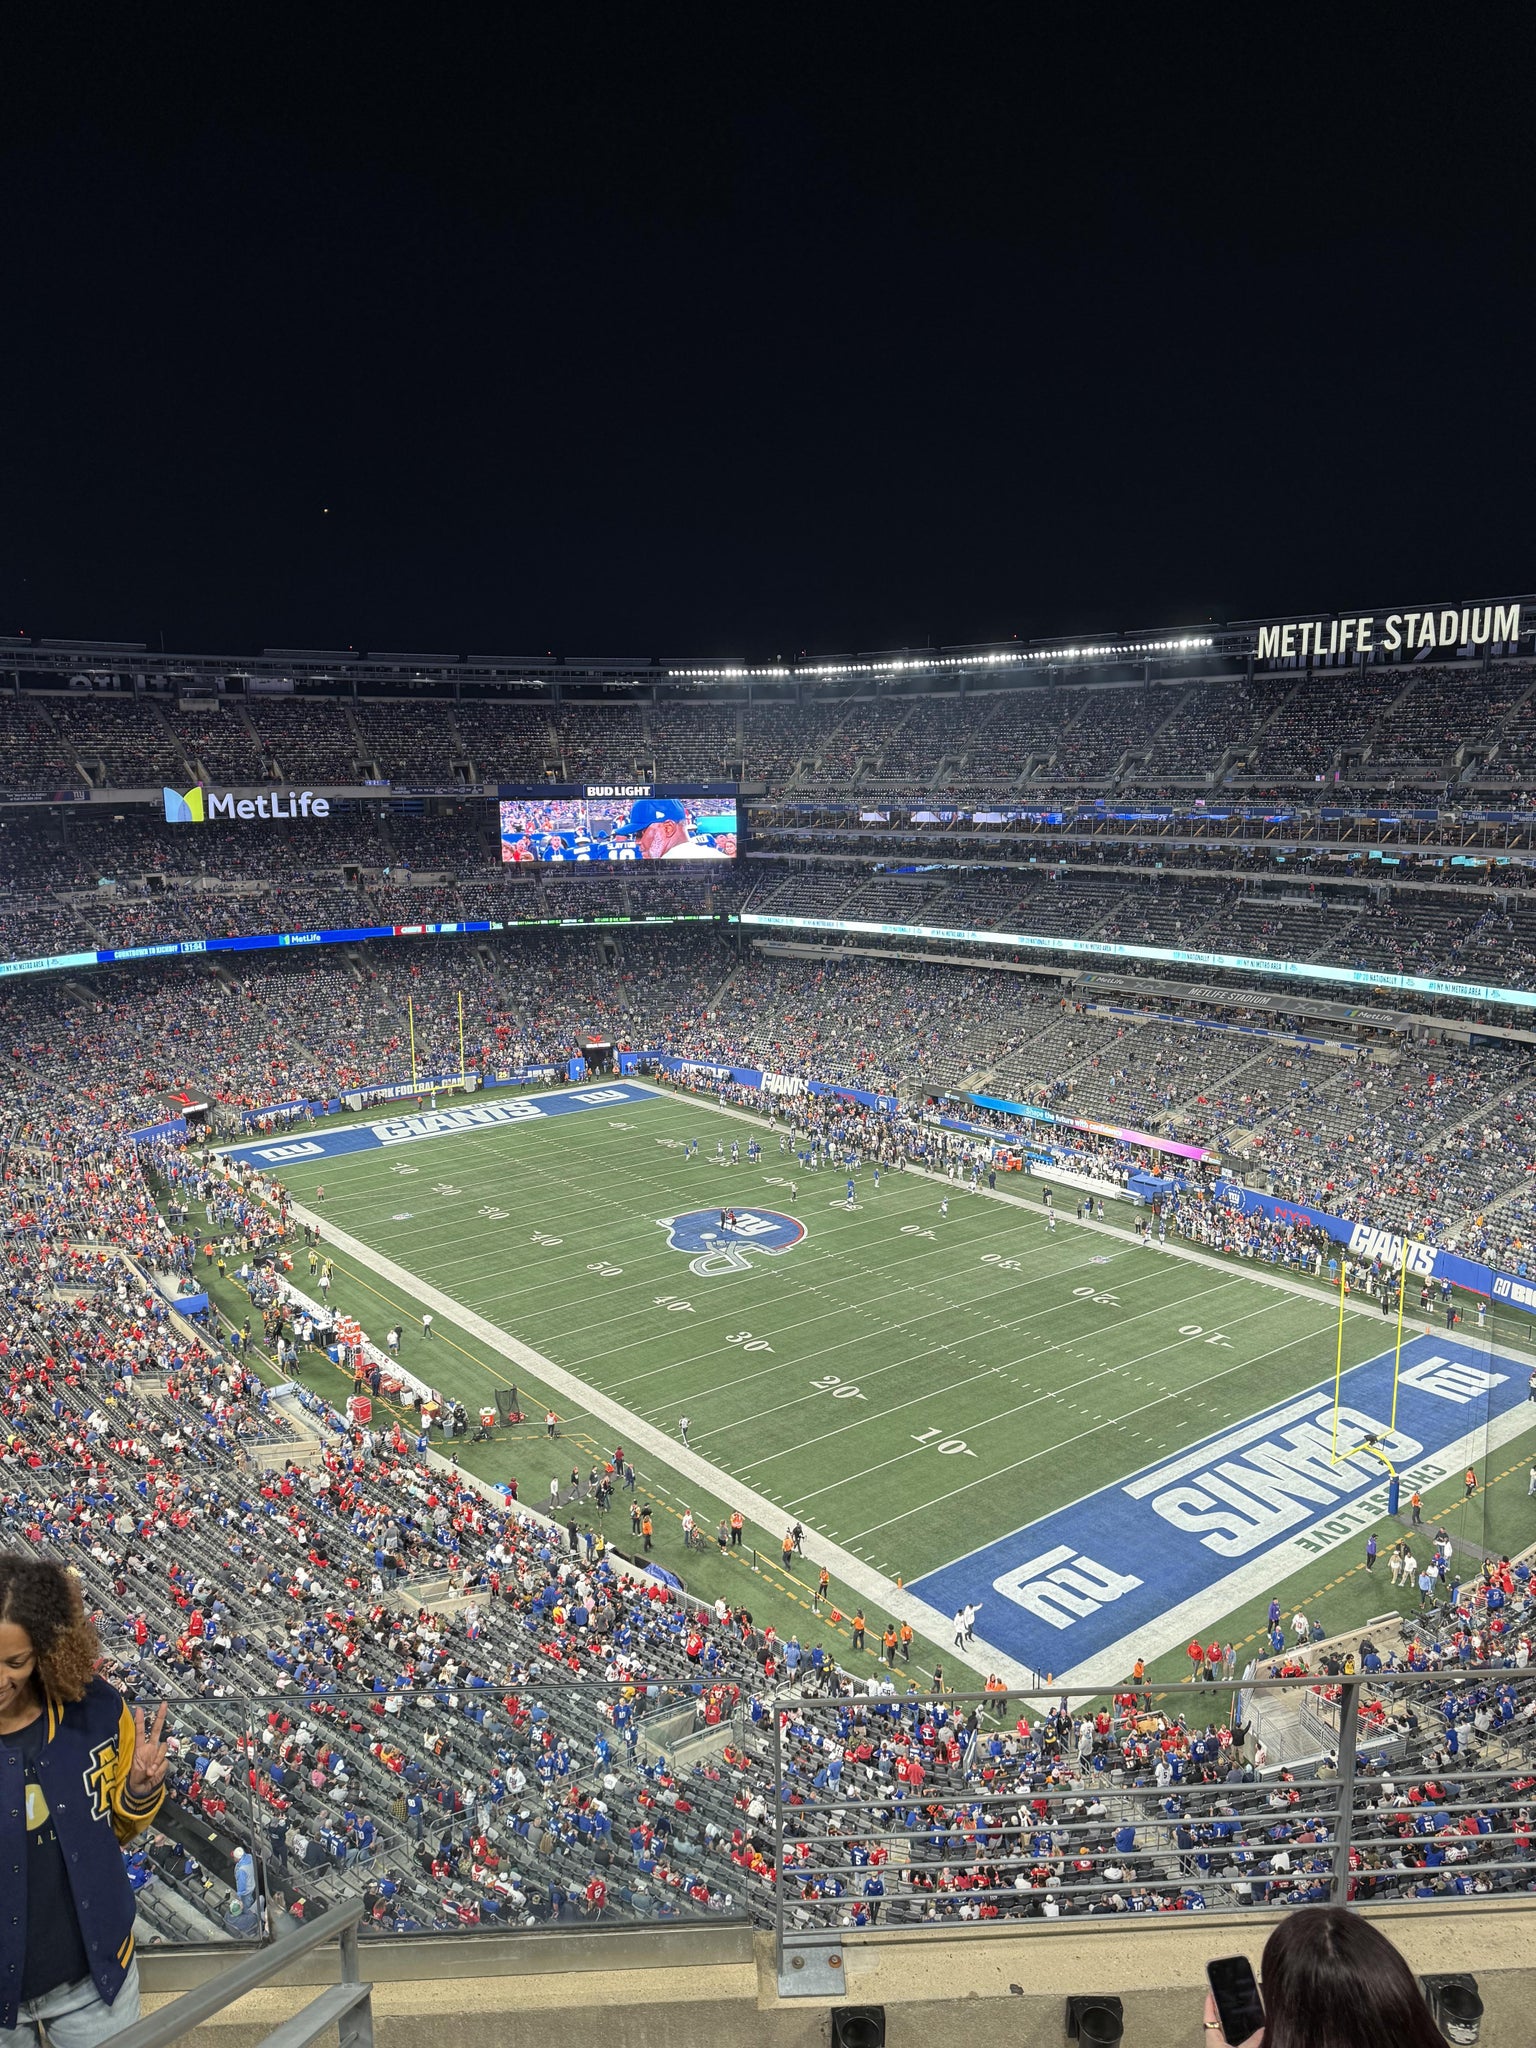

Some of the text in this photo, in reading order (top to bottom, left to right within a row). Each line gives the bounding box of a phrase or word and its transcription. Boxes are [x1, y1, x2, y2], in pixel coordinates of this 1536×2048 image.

[1258, 604, 1520, 660] METLIFE STADIUM
[587, 786, 651, 797] BUD LIGHT
[208, 792, 330, 820] MetLife
[291, 934, 321, 944] MetLife
[1095, 976, 1125, 985] MetLife
[1369, 974, 1397, 985] NATIONALLY
[1187, 987, 1272, 1006] METLIFE STADIUM
[1451, 984, 1468, 994] METRO
[1468, 986, 1482, 996] AREA
[1357, 1011, 1393, 1022] MetLife
[371, 1100, 543, 1141] GIANTS
[1055, 1112, 1075, 1126] future
[1075, 1116, 1089, 1129] with
[1089, 1119, 1123, 1138] confidence
[478, 1206, 510, 1220] 30
[530, 1231, 563, 1246] 40
[1349, 1223, 1438, 1276] GIANTS
[587, 1261, 623, 1277] 50
[1493, 1277, 1511, 1297] GO
[652, 1295, 692, 1312] 40
[725, 1331, 769, 1352] 30
[810, 1375, 860, 1399] 20
[911, 1426, 968, 1457] 10
[1152, 1406, 1424, 1558] GIANTS
[1294, 1512, 1366, 1553] LOVE
[1163, 1771, 1168, 1779] 5
